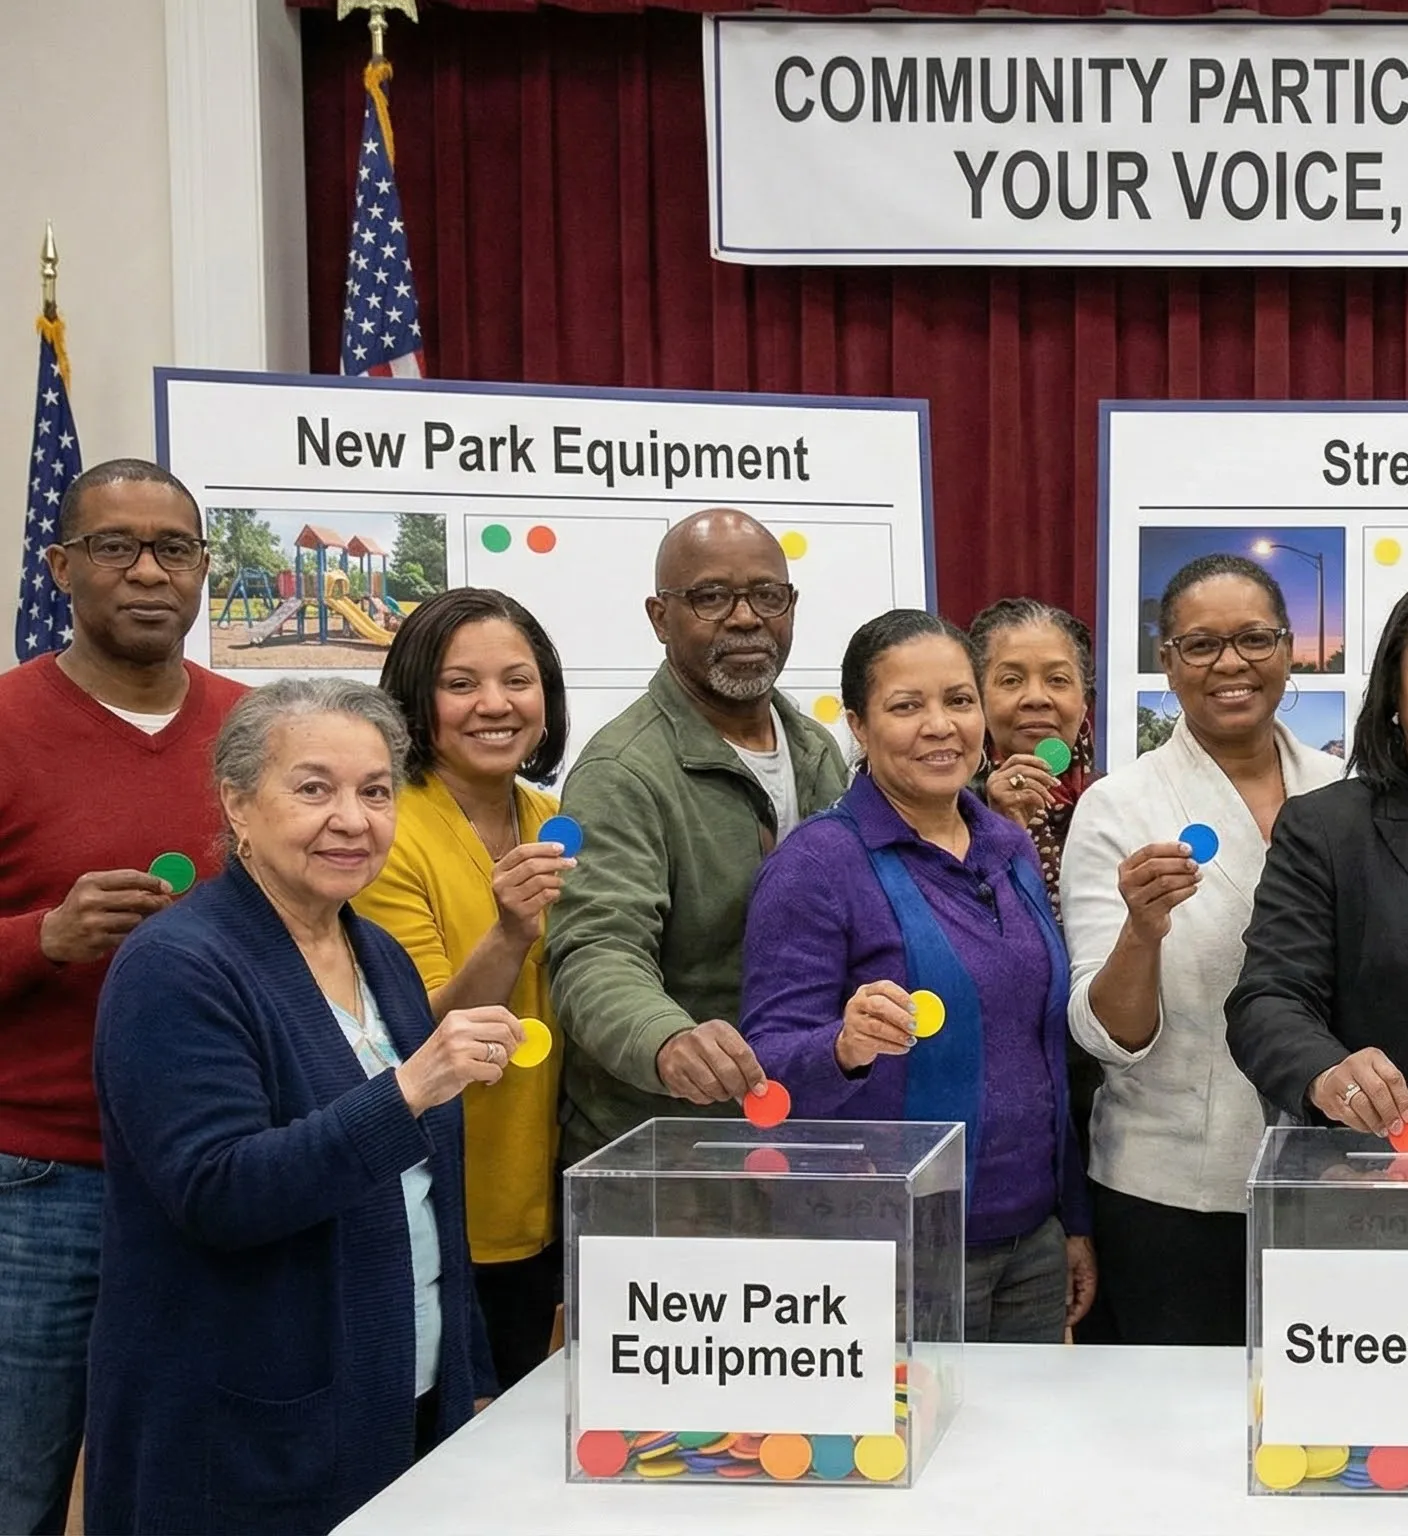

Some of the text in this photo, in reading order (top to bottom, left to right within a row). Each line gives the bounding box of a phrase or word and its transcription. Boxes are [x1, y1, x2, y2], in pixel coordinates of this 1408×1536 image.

[774, 55, 1168, 125] COMMUNITY
[953, 149, 1152, 221] YOUR
[1171, 150, 1402, 234] VOICE,
[297, 416, 811, 490] New Park Equipment
[628, 1281, 847, 1325] New Park
[612, 1334, 863, 1386] Equipment
